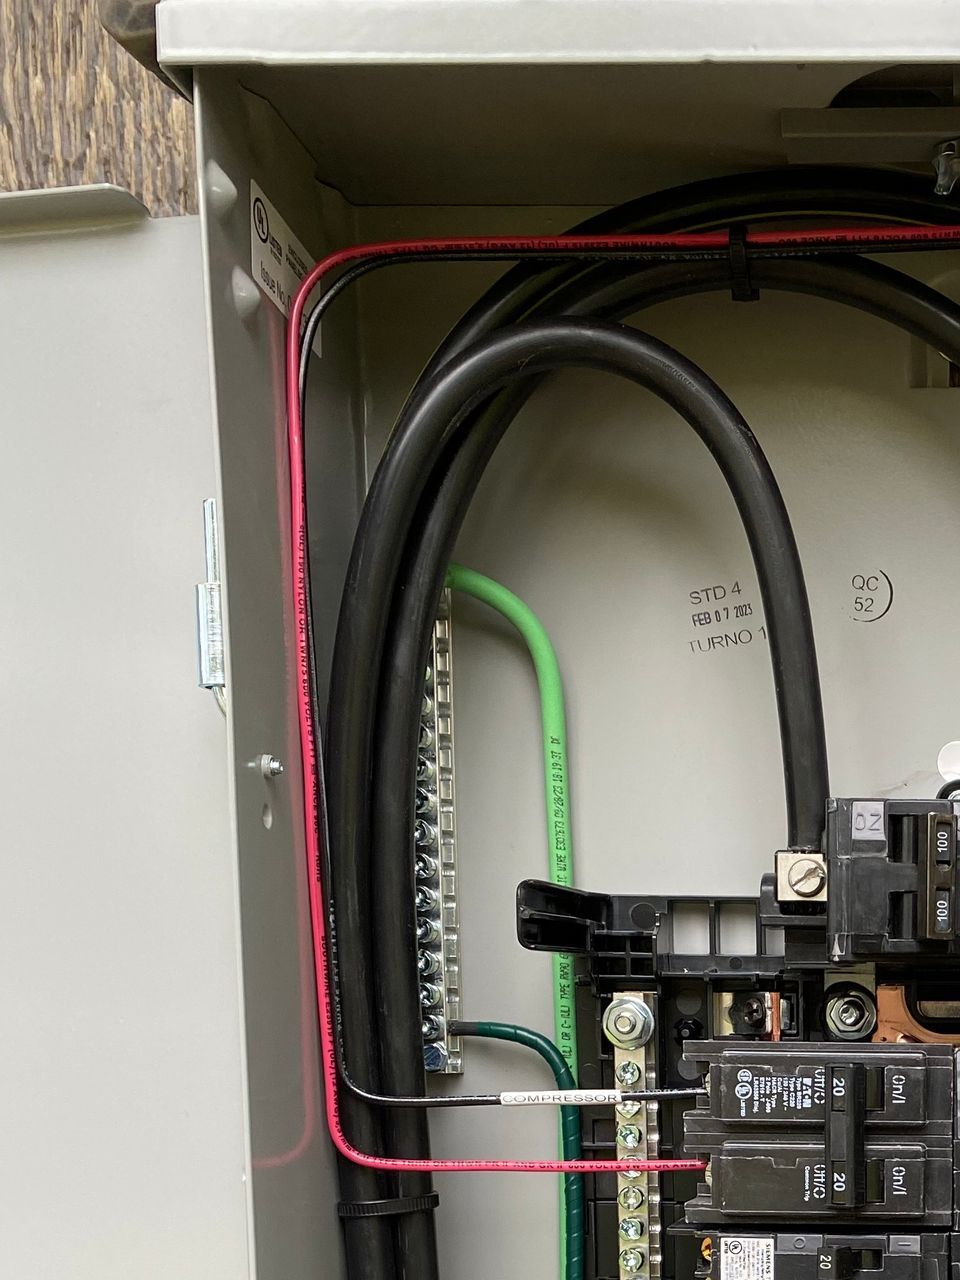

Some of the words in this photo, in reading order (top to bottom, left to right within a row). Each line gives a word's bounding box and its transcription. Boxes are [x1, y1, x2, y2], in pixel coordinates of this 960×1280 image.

[852, 574, 879, 592] QC
[689, 585, 726, 605] STD
[732, 581, 742, 596] 4
[854, 598, 874, 612] 52
[692, 612, 711, 627] FEB
[734, 603, 752, 618] 2023
[688, 629, 752, 653] TURNO
[936, 831, 948, 854] 100
[557, 854, 566, 871] WIRE
[936, 900, 948, 923] 100
[560, 981, 570, 1000] TYPE
[833, 1078, 845, 1096] 20
[502, 1093, 618, 1103] COMPRESSOR
[834, 1172, 846, 1192] 20
[820, 1255, 832, 1270] 20
